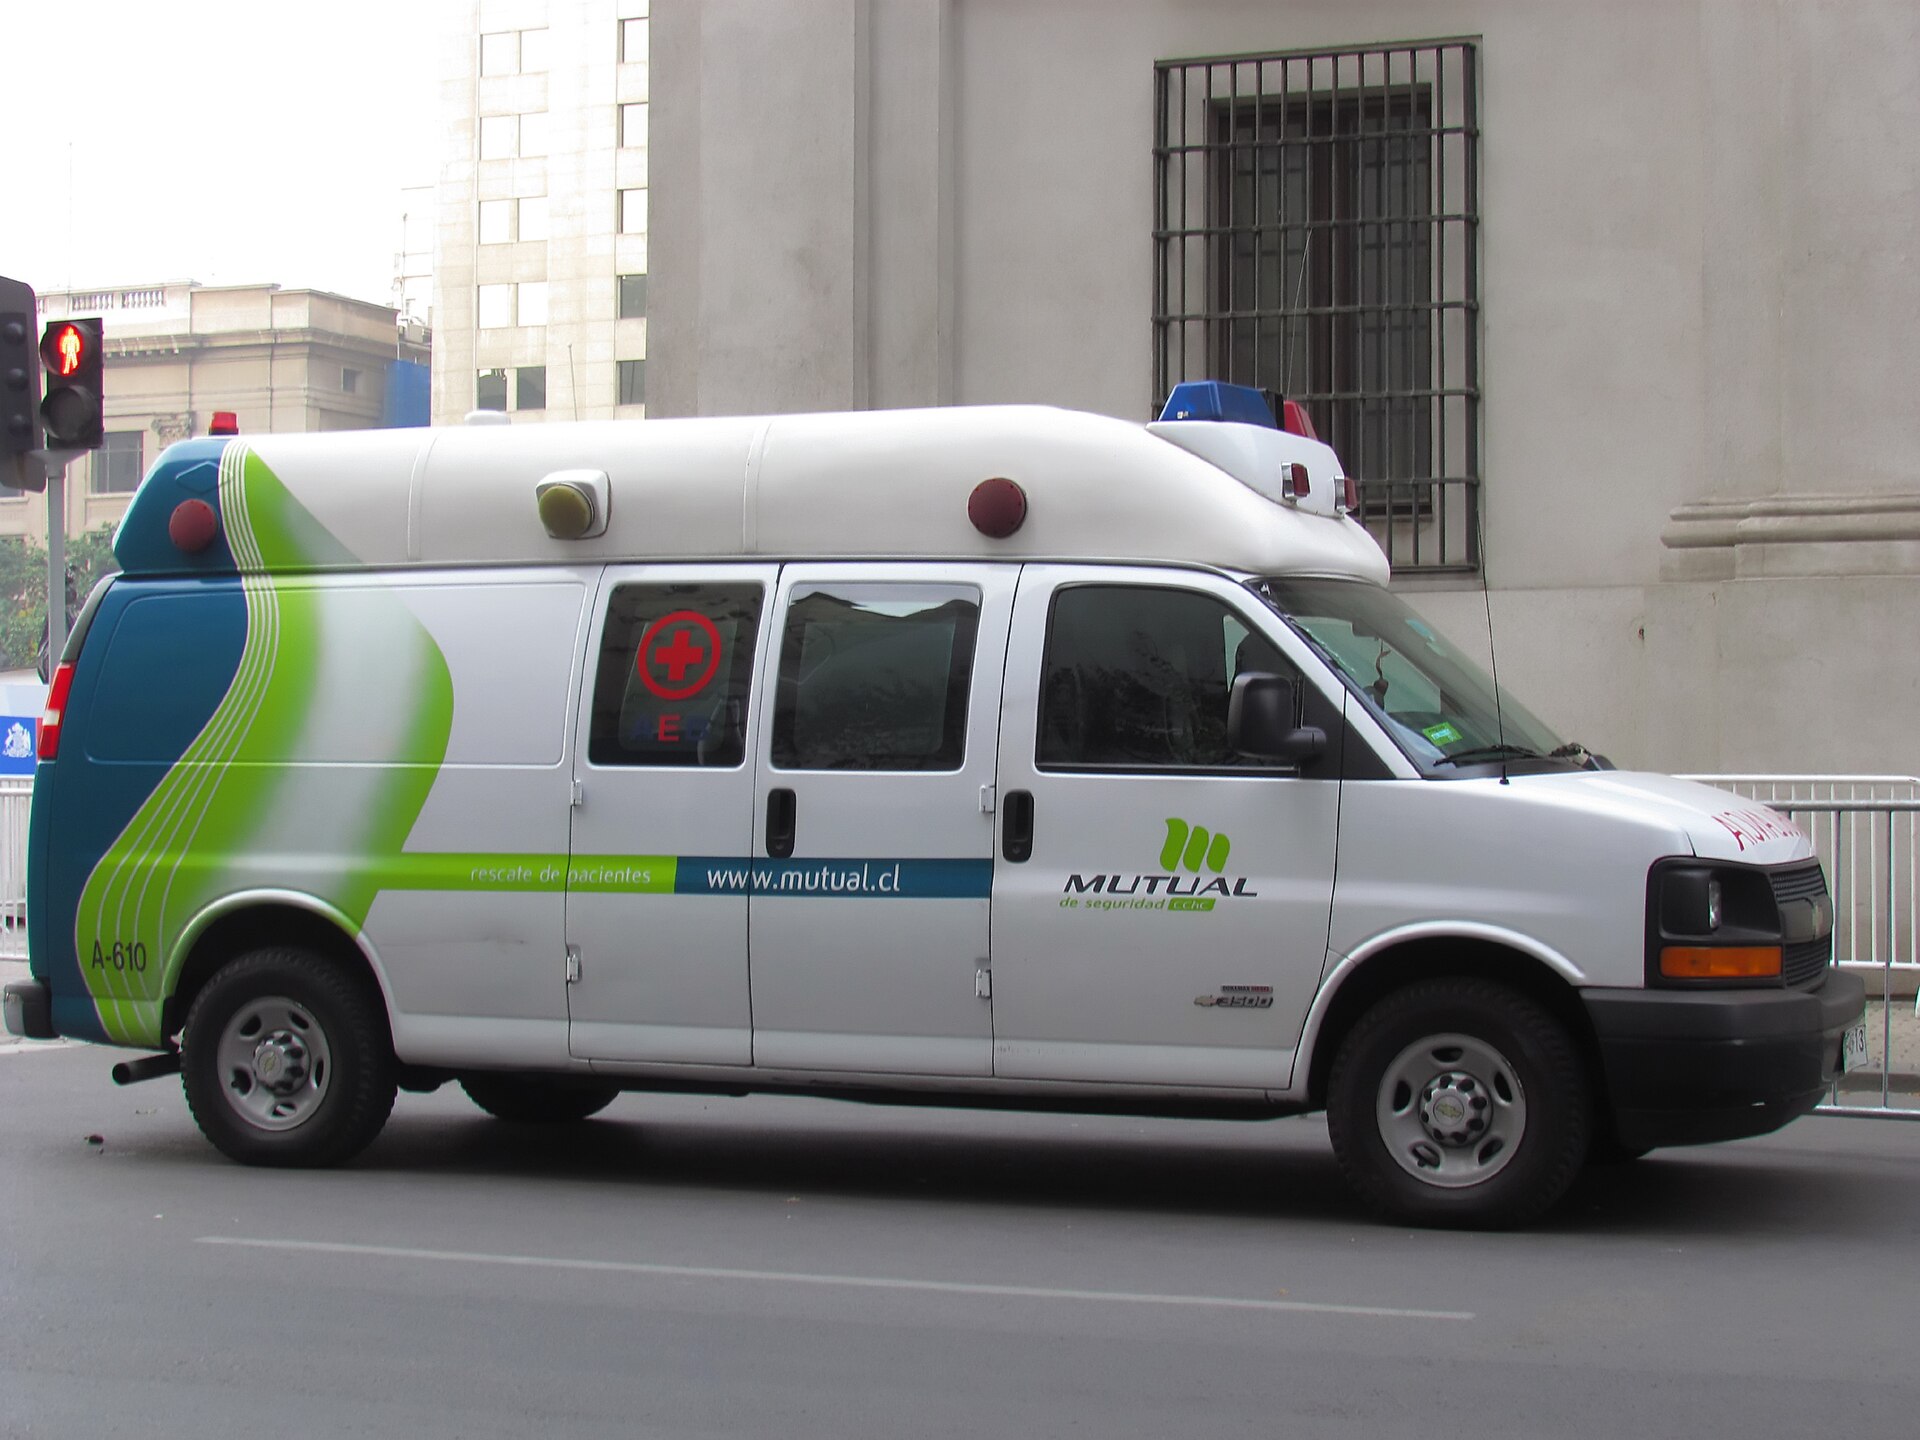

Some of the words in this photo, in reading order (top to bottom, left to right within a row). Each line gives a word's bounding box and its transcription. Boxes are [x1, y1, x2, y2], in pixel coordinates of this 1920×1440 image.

[471, 865, 532, 882] rescate
[540, 864, 560, 882] de
[567, 865, 651, 888] pacientes
[706, 862, 901, 892] www.mutual.cl
[1063, 874, 1258, 897] MUTUAL
[1059, 896, 1078, 908] de
[1085, 898, 1166, 911] seguridad
[92, 939, 147, 972] A-610
